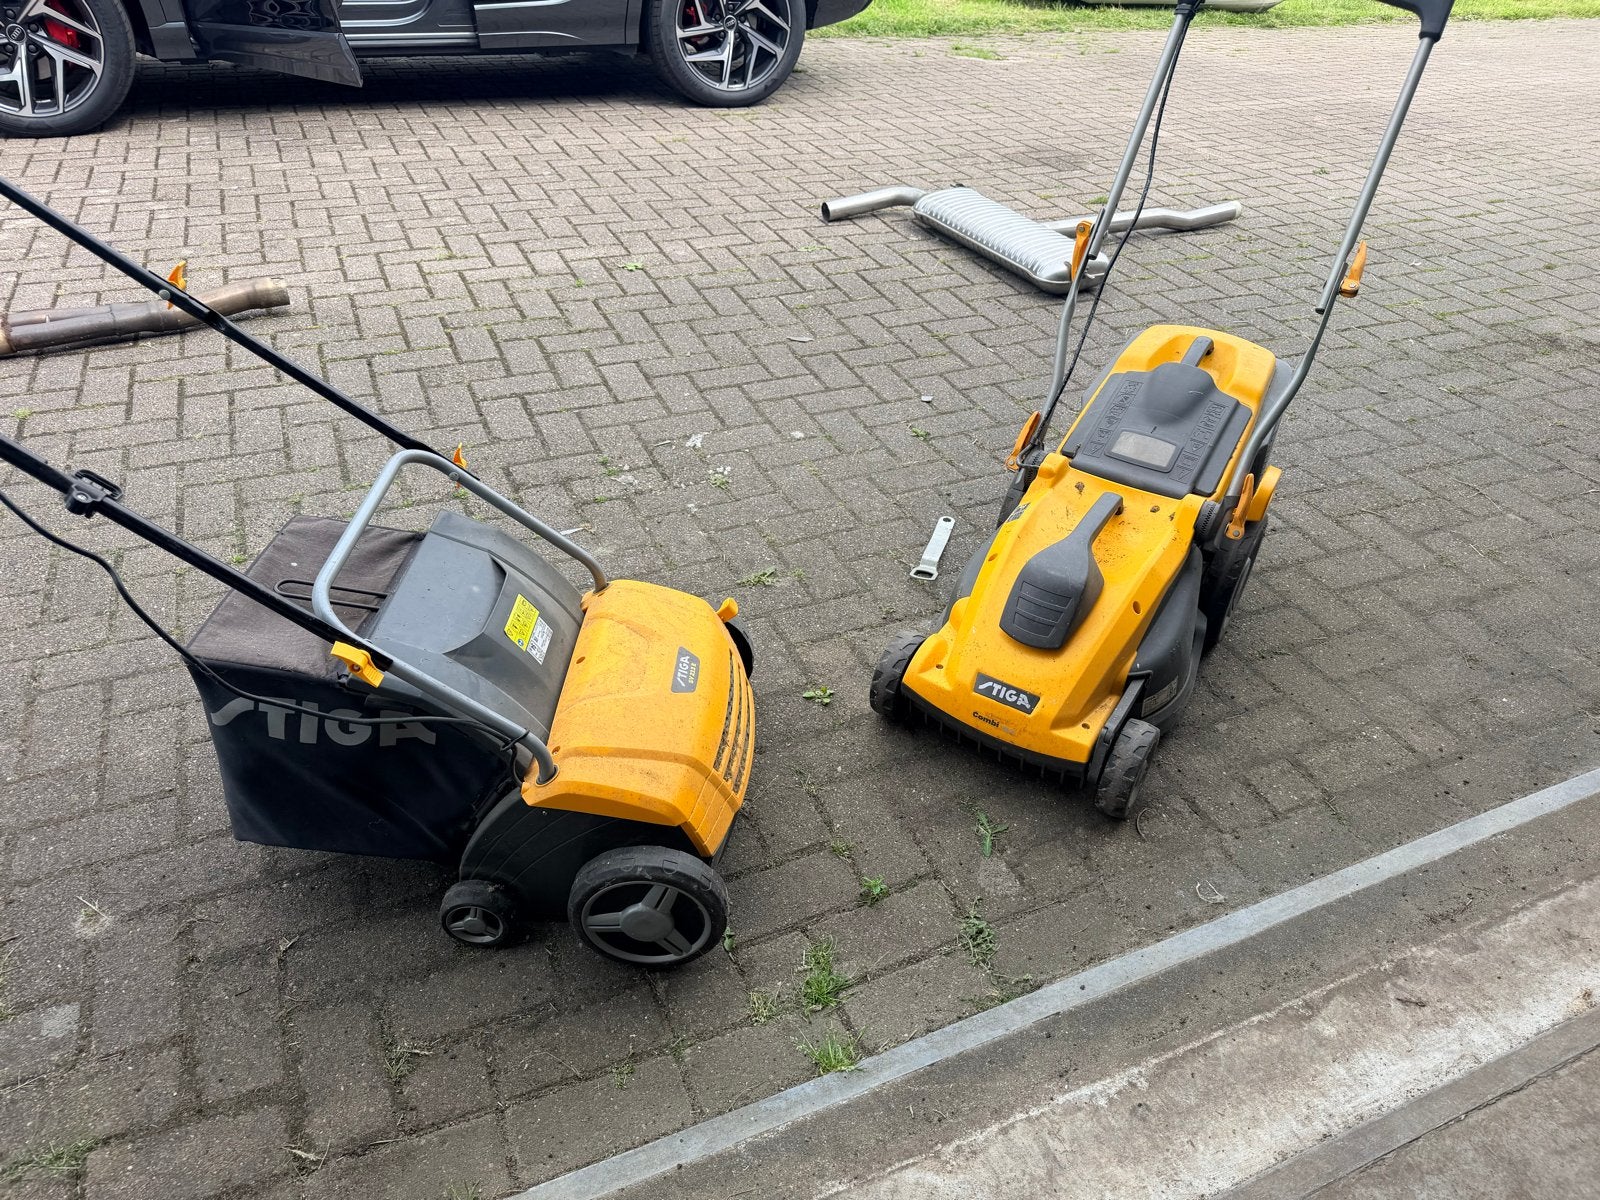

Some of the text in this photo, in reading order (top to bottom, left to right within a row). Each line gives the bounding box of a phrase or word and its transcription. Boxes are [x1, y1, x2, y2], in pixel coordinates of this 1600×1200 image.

[677, 656, 690, 687] STIGA
[978, 681, 1031, 709] STIGA
[210, 696, 437, 746] STIGA
[972, 711, 999, 728] Combi
